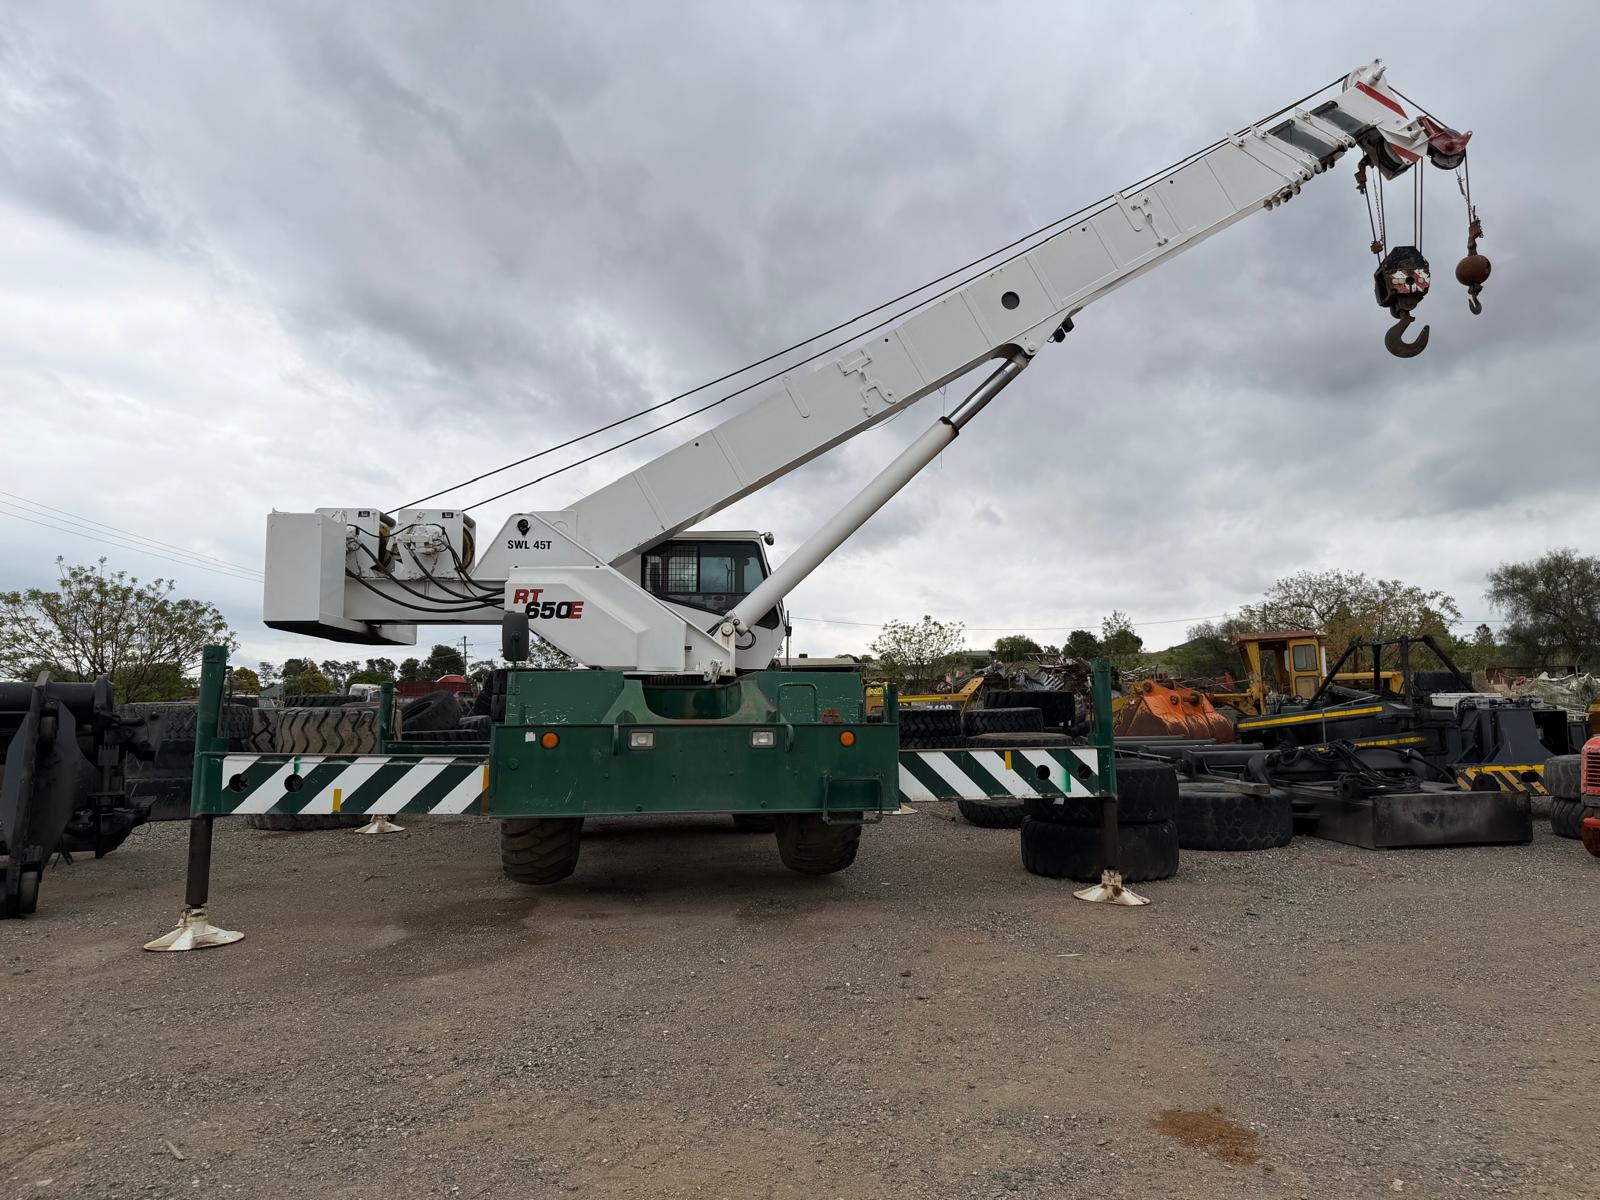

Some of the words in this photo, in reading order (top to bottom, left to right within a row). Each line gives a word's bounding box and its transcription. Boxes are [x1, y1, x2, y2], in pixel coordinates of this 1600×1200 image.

[507, 540, 530, 549] SWL
[533, 541, 552, 549] 45T
[513, 589, 544, 604] RT
[525, 601, 584, 619] 650E
